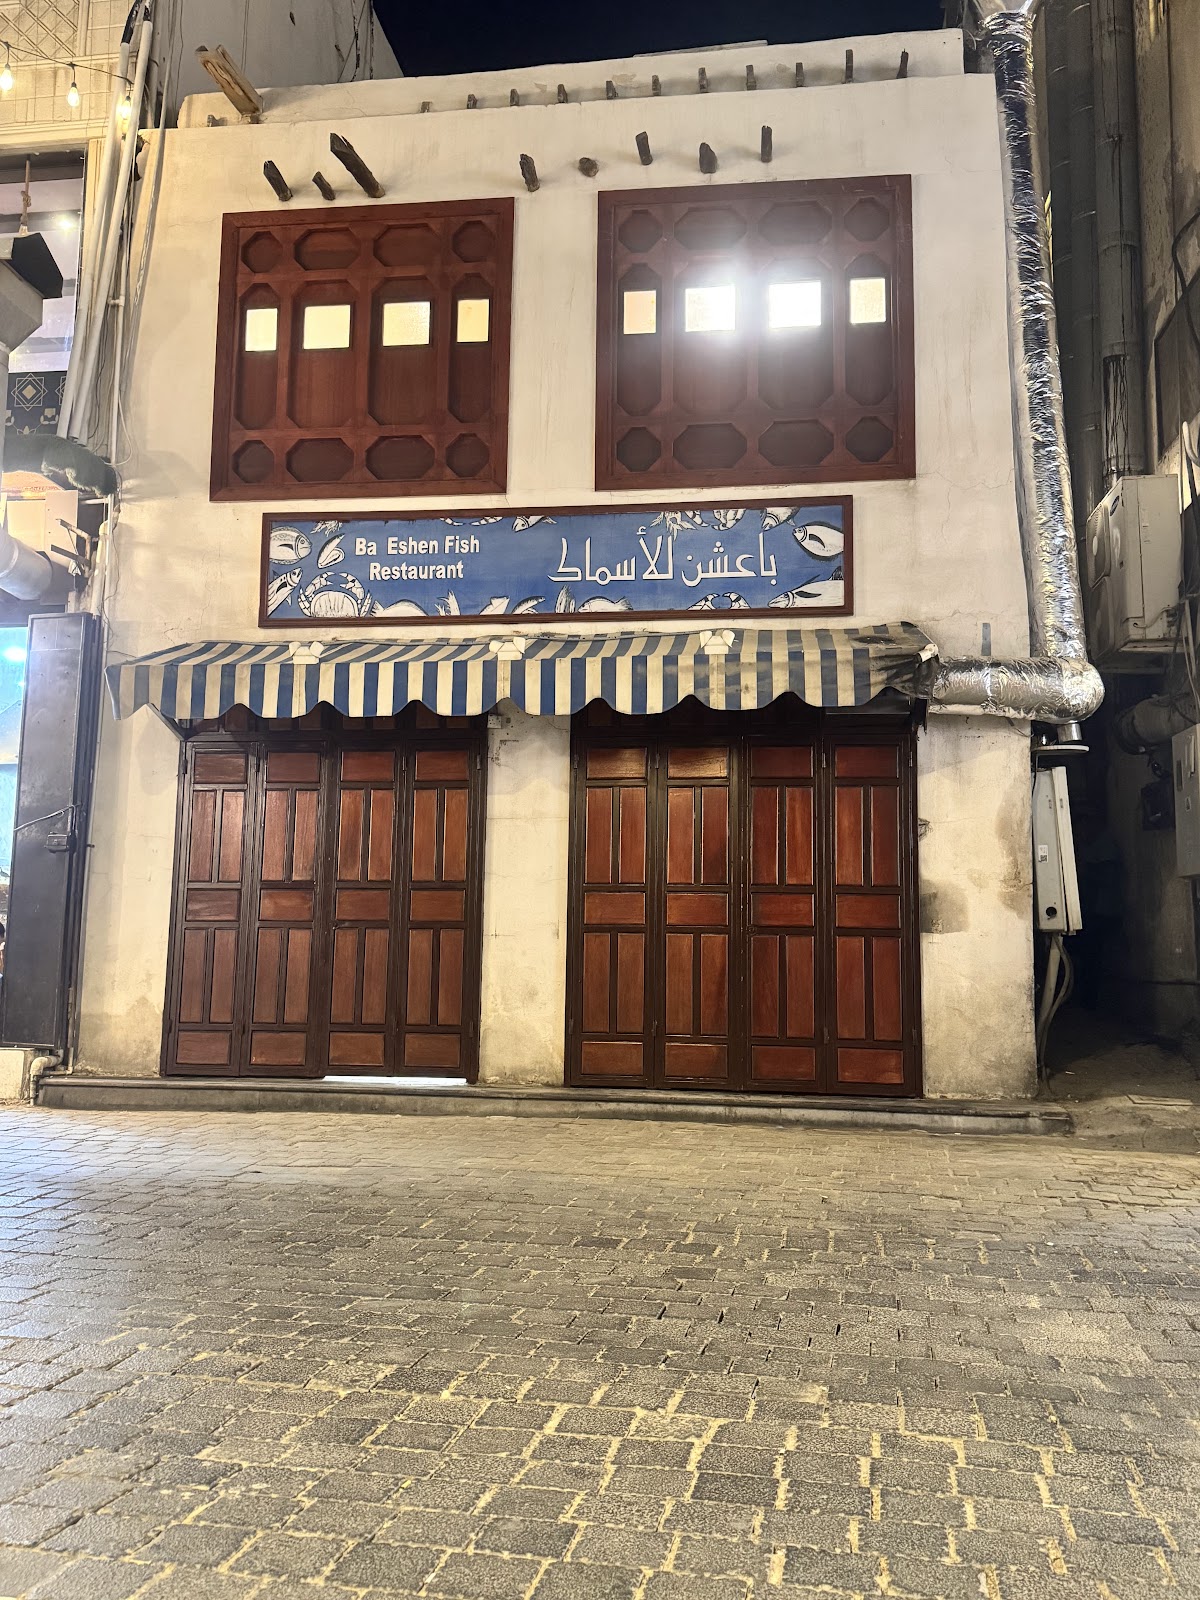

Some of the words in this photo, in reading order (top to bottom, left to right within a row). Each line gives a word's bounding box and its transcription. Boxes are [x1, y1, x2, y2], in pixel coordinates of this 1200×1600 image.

[355, 537, 377, 556] Ba
[387, 536, 439, 555] Eshen
[444, 535, 480, 554] Fish
[547, 525, 674, 586] للأسماك
[681, 532, 777, 587] باعشن
[369, 560, 464, 581] Restaurant
